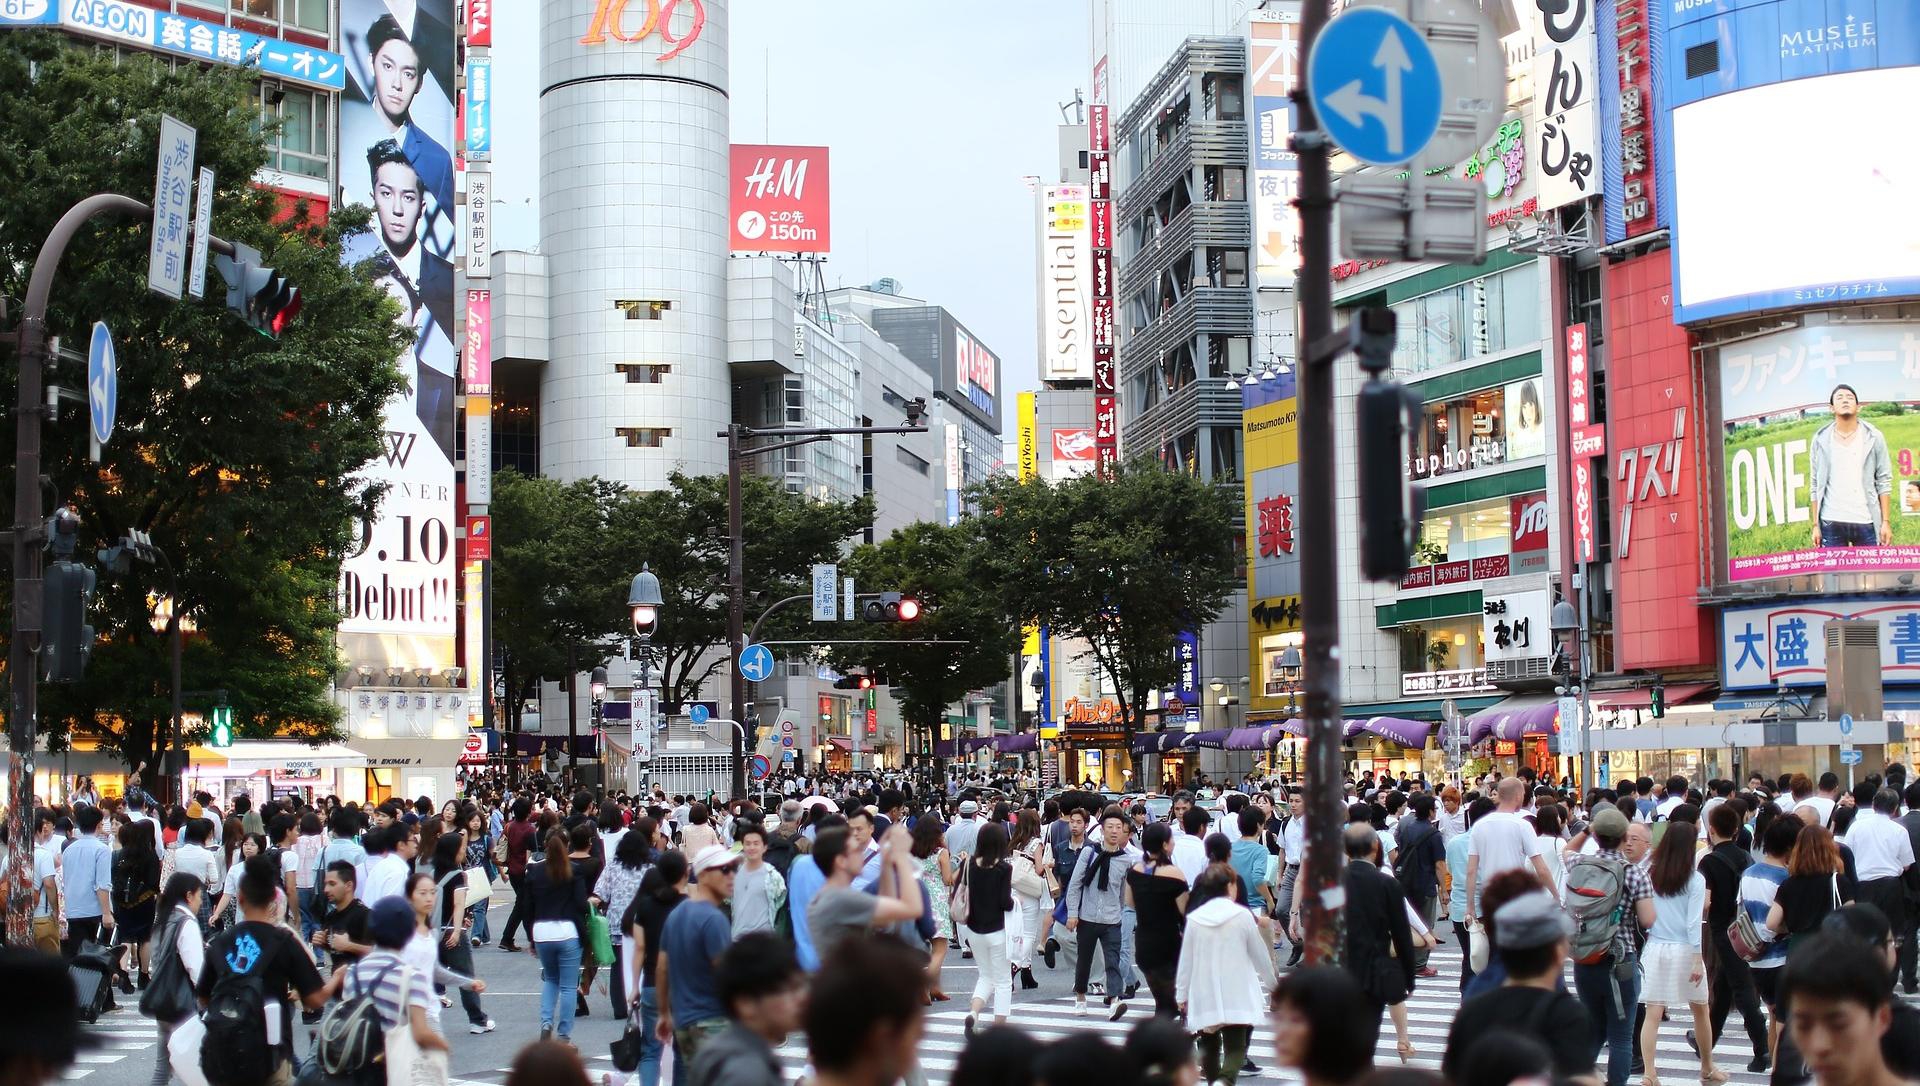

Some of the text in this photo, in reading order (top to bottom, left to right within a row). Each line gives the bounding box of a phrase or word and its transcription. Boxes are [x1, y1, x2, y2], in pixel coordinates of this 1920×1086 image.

[472, 0, 488, 35] スト
[578, 0, 706, 61] 109
[73, 0, 338, 80] AEON 英会話イーオン
[1781, 38, 1877, 58] PLATINUM
[157, 155, 172, 220] Shibuya
[744, 158, 809, 200] H&M
[165, 137, 189, 282] 渋谷駅前
[472, 182, 485, 268] 渋谷駅前ビル
[769, 210, 805, 224] この先
[769, 223, 817, 241] 150m
[468, 291, 489, 301] 5F
[1049, 235, 1077, 374] Essential
[1794, 282, 1888, 300] ミュゼプラチナム
[1247, 415, 1285, 433] Matsumoto
[1897, 448, 1920, 477] 9.
[1732, 439, 1810, 530] ONE
[1258, 494, 1293, 557] 薬
[1514, 501, 1547, 540] JTB
[1437, 565, 1467, 580] 海外旅行
[1475, 557, 1506, 568] ハネムーン
[1880, 549, 1897, 557] FOR
[345, 571, 448, 622] Debut!!
[823, 569, 834, 616] 渋谷駅前
[1734, 612, 1920, 672] 大盛書
[634, 697, 644, 755] 道玄坂
